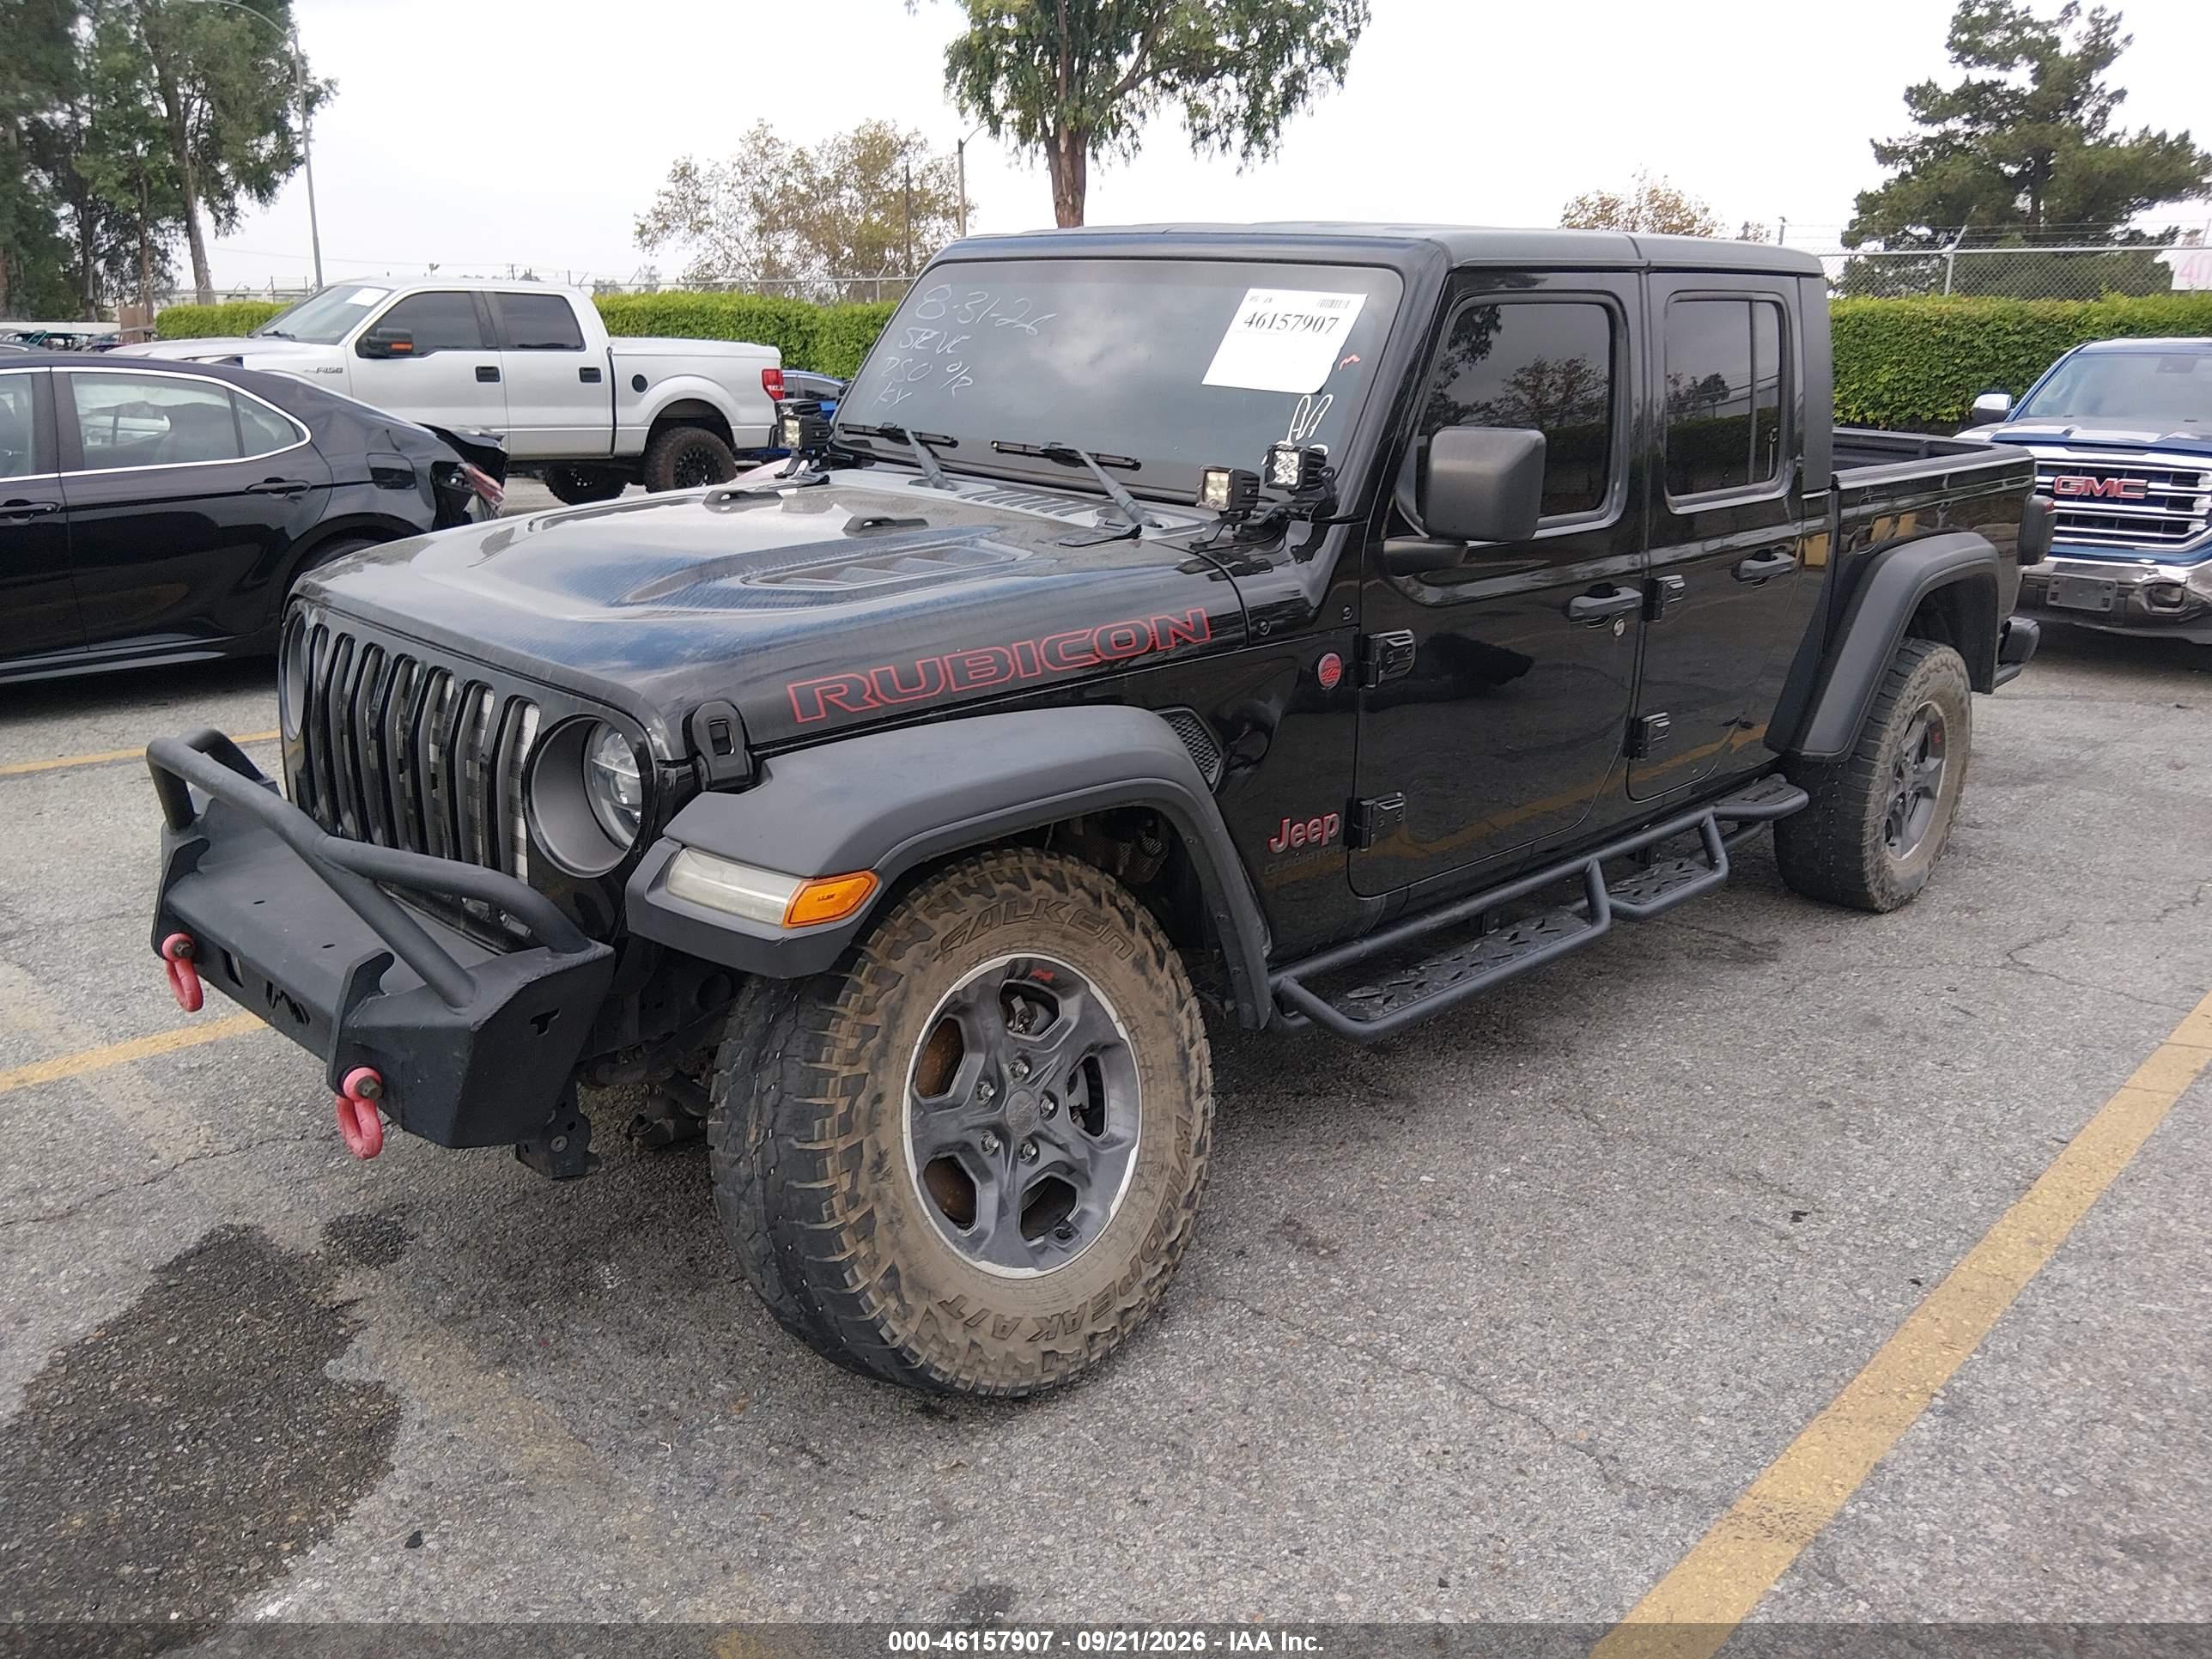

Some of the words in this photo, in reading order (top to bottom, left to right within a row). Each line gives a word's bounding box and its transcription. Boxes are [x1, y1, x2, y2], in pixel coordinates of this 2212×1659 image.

[1243, 311, 1340, 334] 46157907
[2053, 475, 2148, 499] GMC
[787, 607, 1211, 723] RUBICON
[1267, 811, 1340, 853] Jeep
[933, 898, 1134, 962] FALKEN
